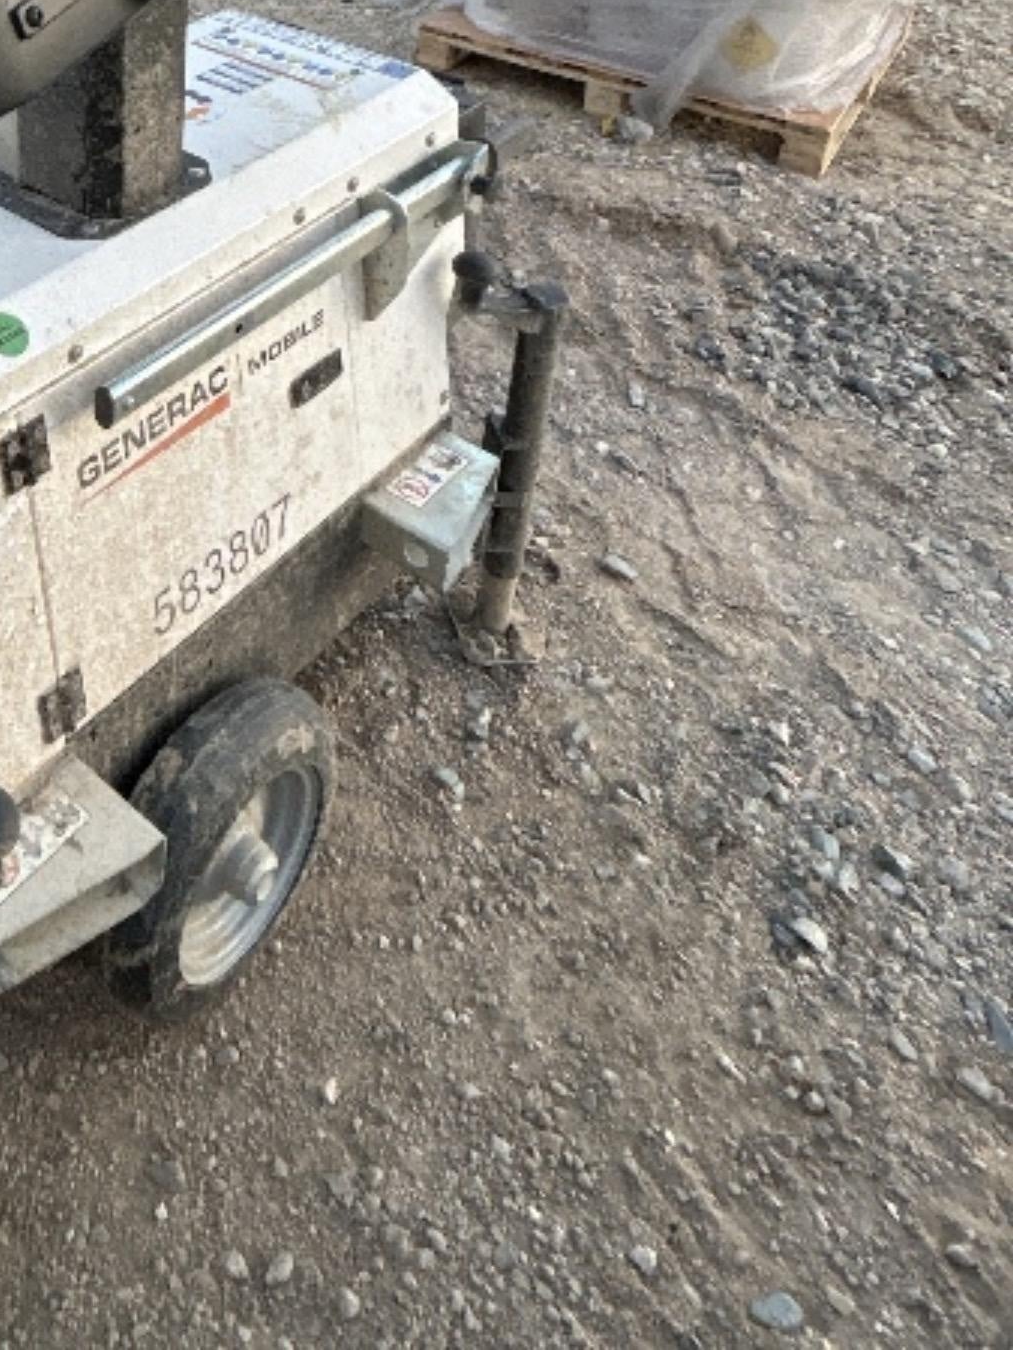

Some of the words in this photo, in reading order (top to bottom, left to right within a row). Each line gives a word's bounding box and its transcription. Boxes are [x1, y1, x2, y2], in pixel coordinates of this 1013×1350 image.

[76, 365, 229, 490] GENERAC
[246, 309, 325, 377] MOBILE
[154, 491, 291, 635] 583807
